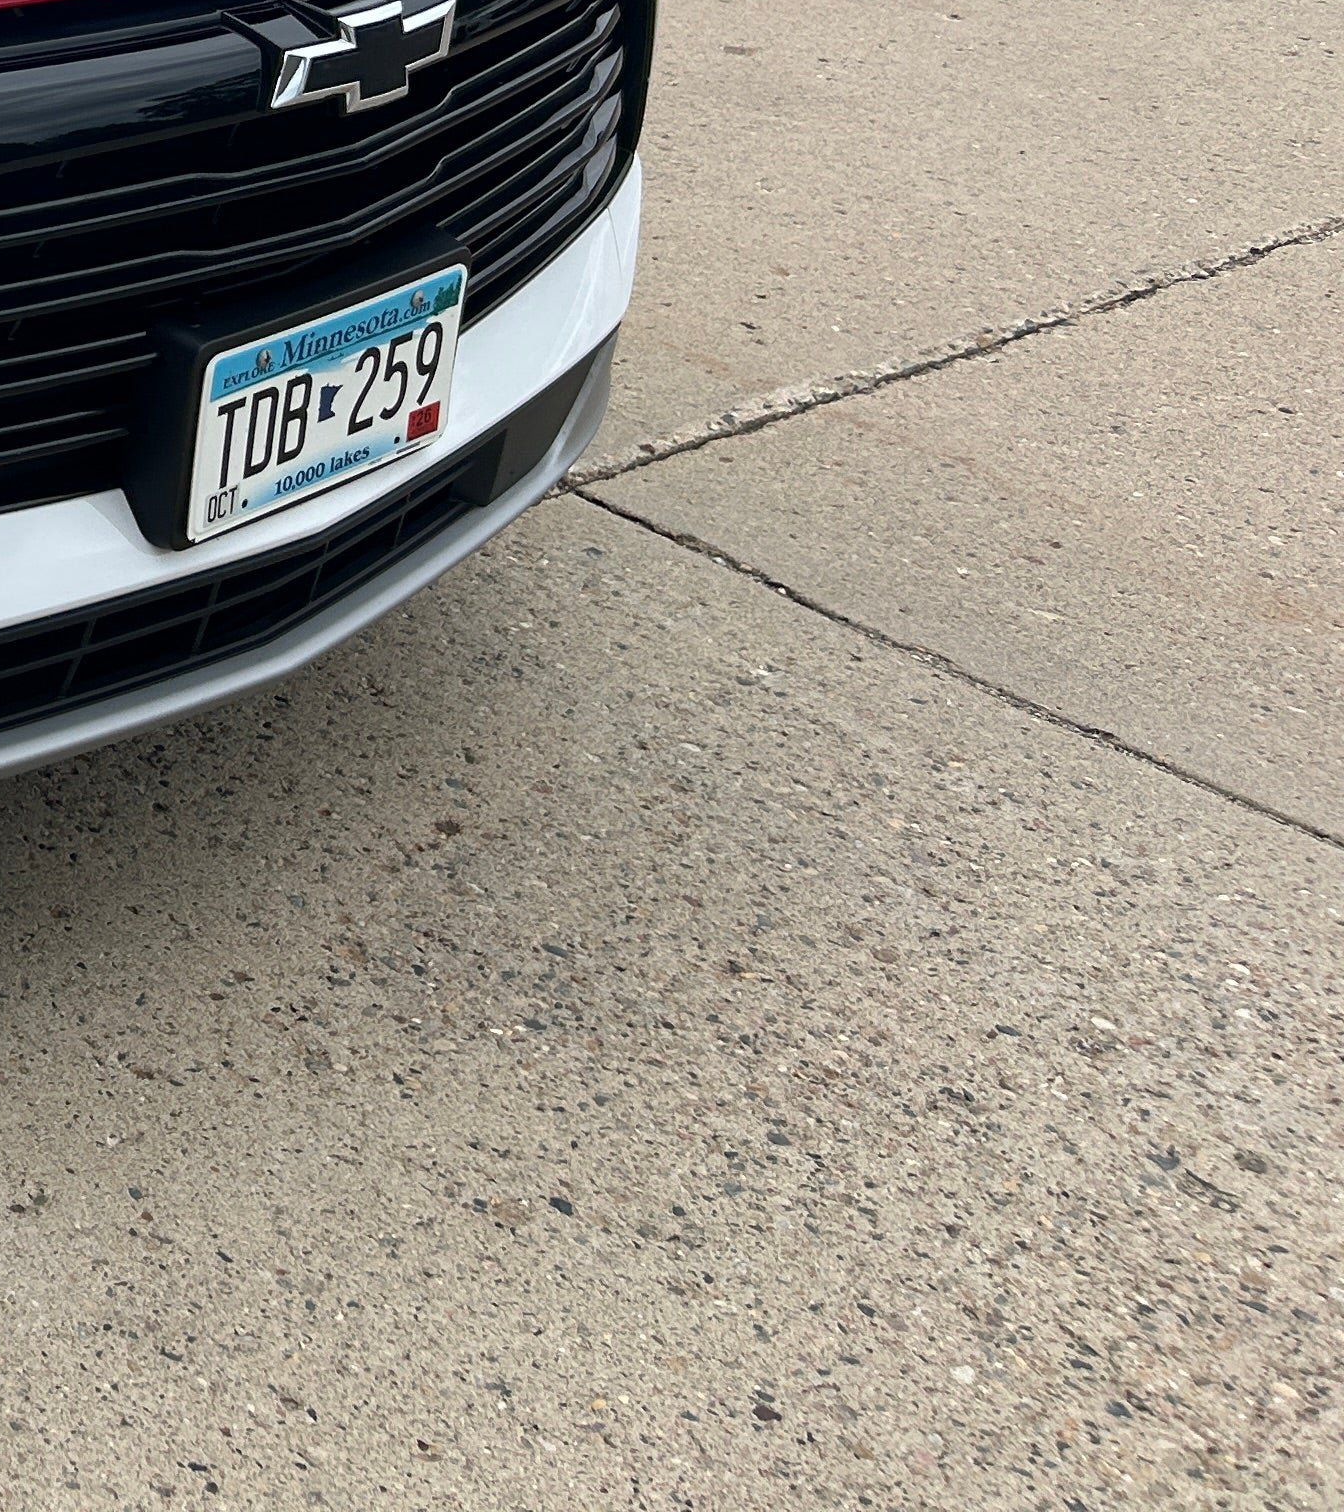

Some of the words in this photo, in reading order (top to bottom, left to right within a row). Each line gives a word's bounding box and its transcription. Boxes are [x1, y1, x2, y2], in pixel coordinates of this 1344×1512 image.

[280, 301, 431, 368] Minnesota.com
[217, 372, 313, 489] TDB
[347, 321, 443, 436] 259
[274, 462, 326, 496] 10,000
[329, 446, 370, 473] lakes
[207, 485, 238, 523] OCT
